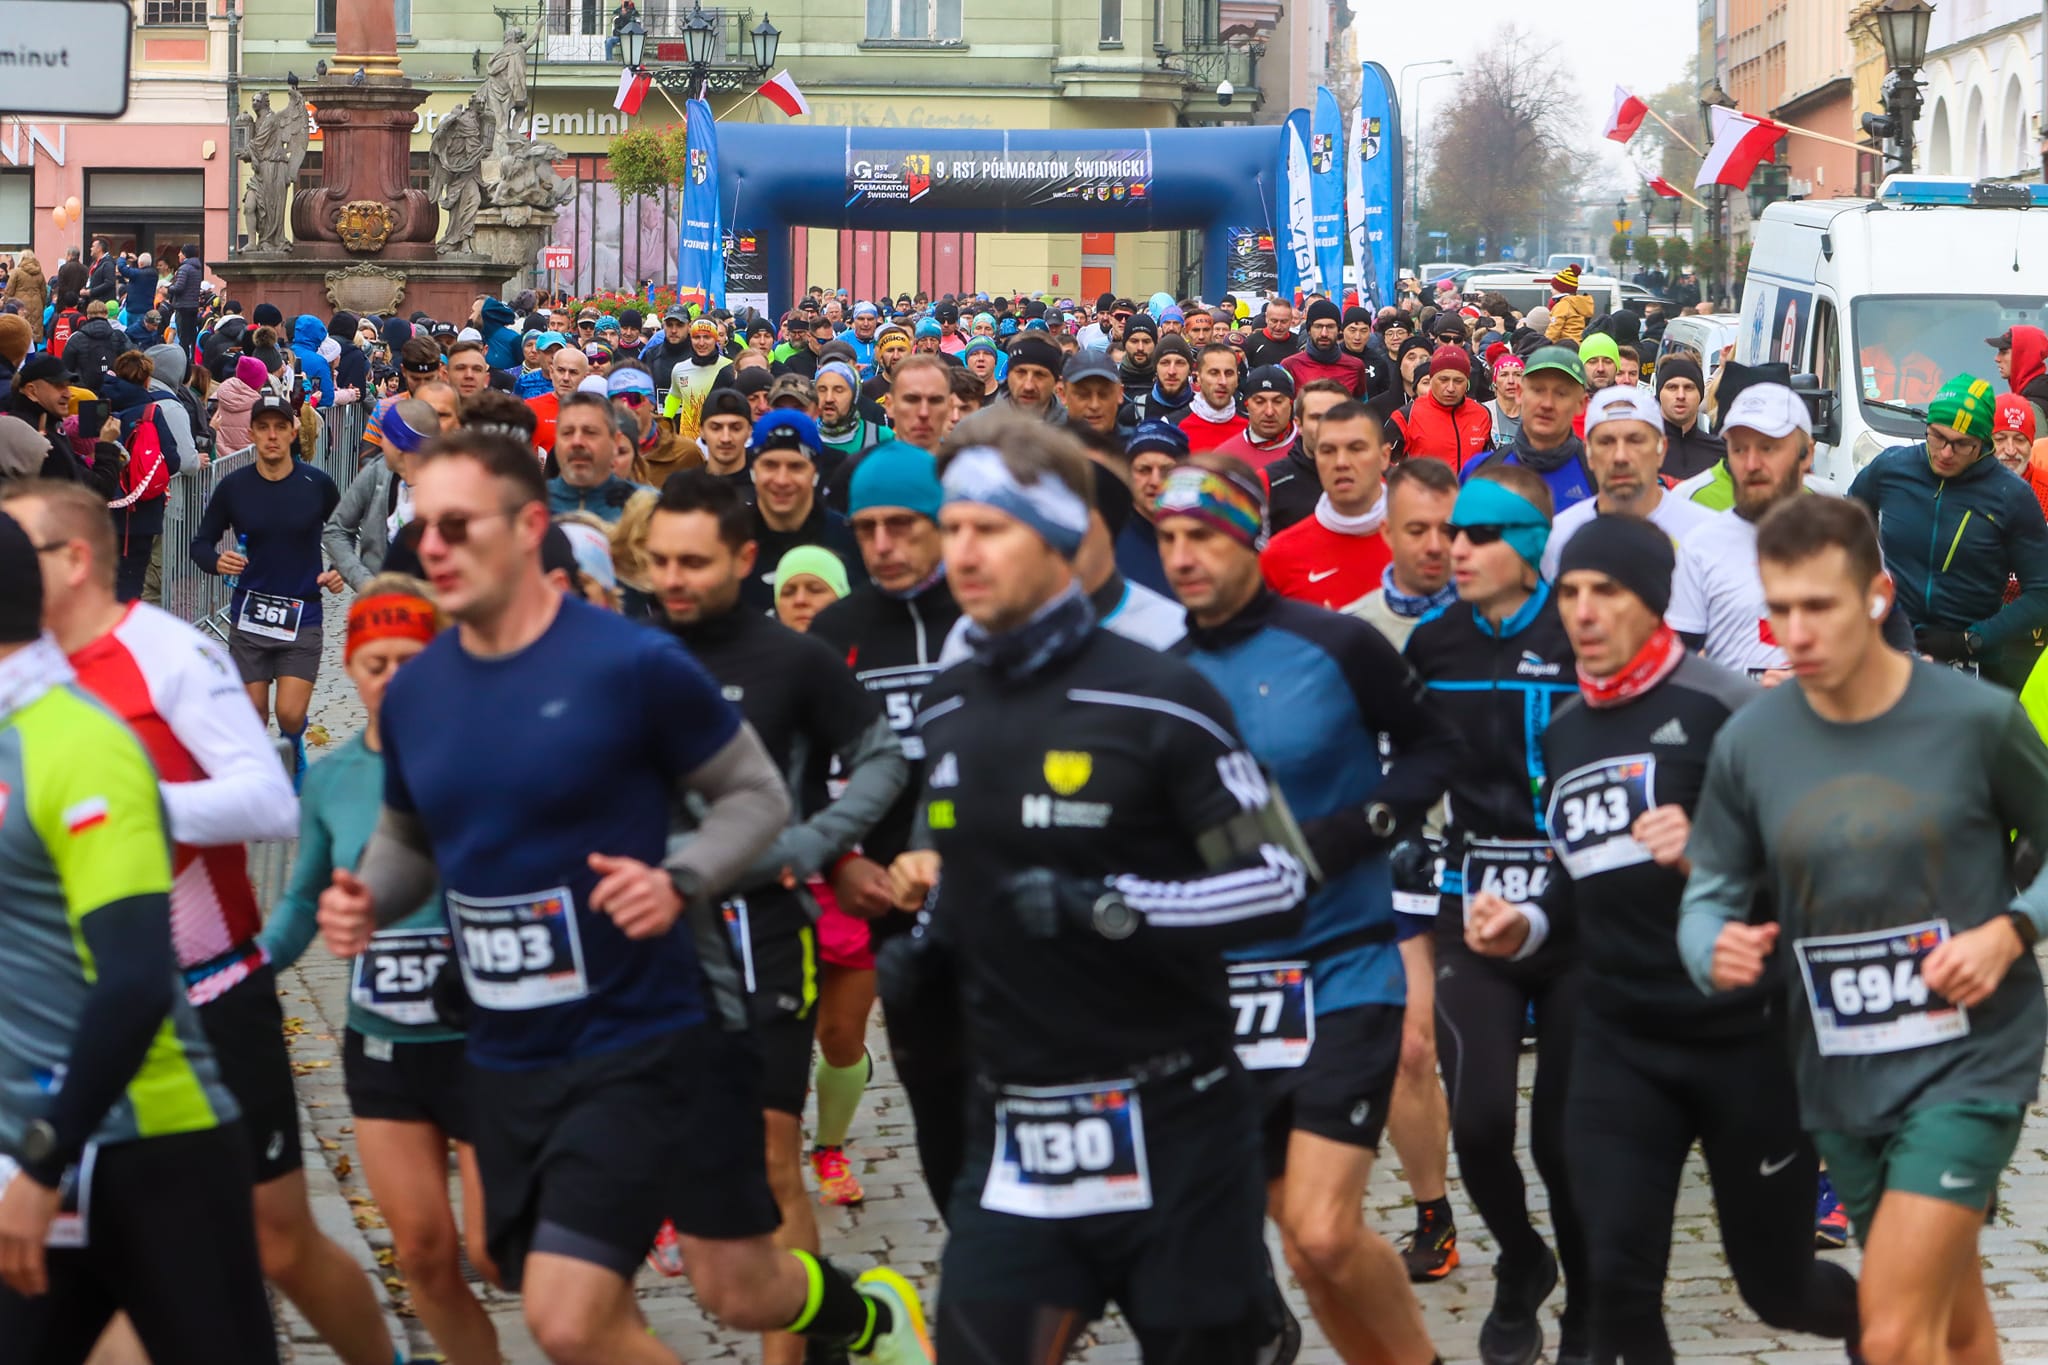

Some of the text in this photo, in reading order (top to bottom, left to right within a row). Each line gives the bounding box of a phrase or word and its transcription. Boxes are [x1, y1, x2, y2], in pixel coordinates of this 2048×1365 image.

[759, 102, 900, 128] ATEKA
[874, 172, 898, 180] Group
[936, 156, 1145, 179] 9. RST PÓŁMARATON ŚWIDNICKI
[853, 183, 909, 200] PÓŁMARATON ŚWIDNICKI
[744, 273, 763, 281] Group
[1263, 271, 1279, 279] Grou
[254, 602, 288, 625] 361
[885, 691, 922, 731] 5
[1563, 785, 1630, 843] 343
[1480, 865, 1550, 902] 484
[463, 924, 554, 973] 1193
[1830, 959, 1929, 1016] 694
[1014, 1118, 1115, 1175] 1130
